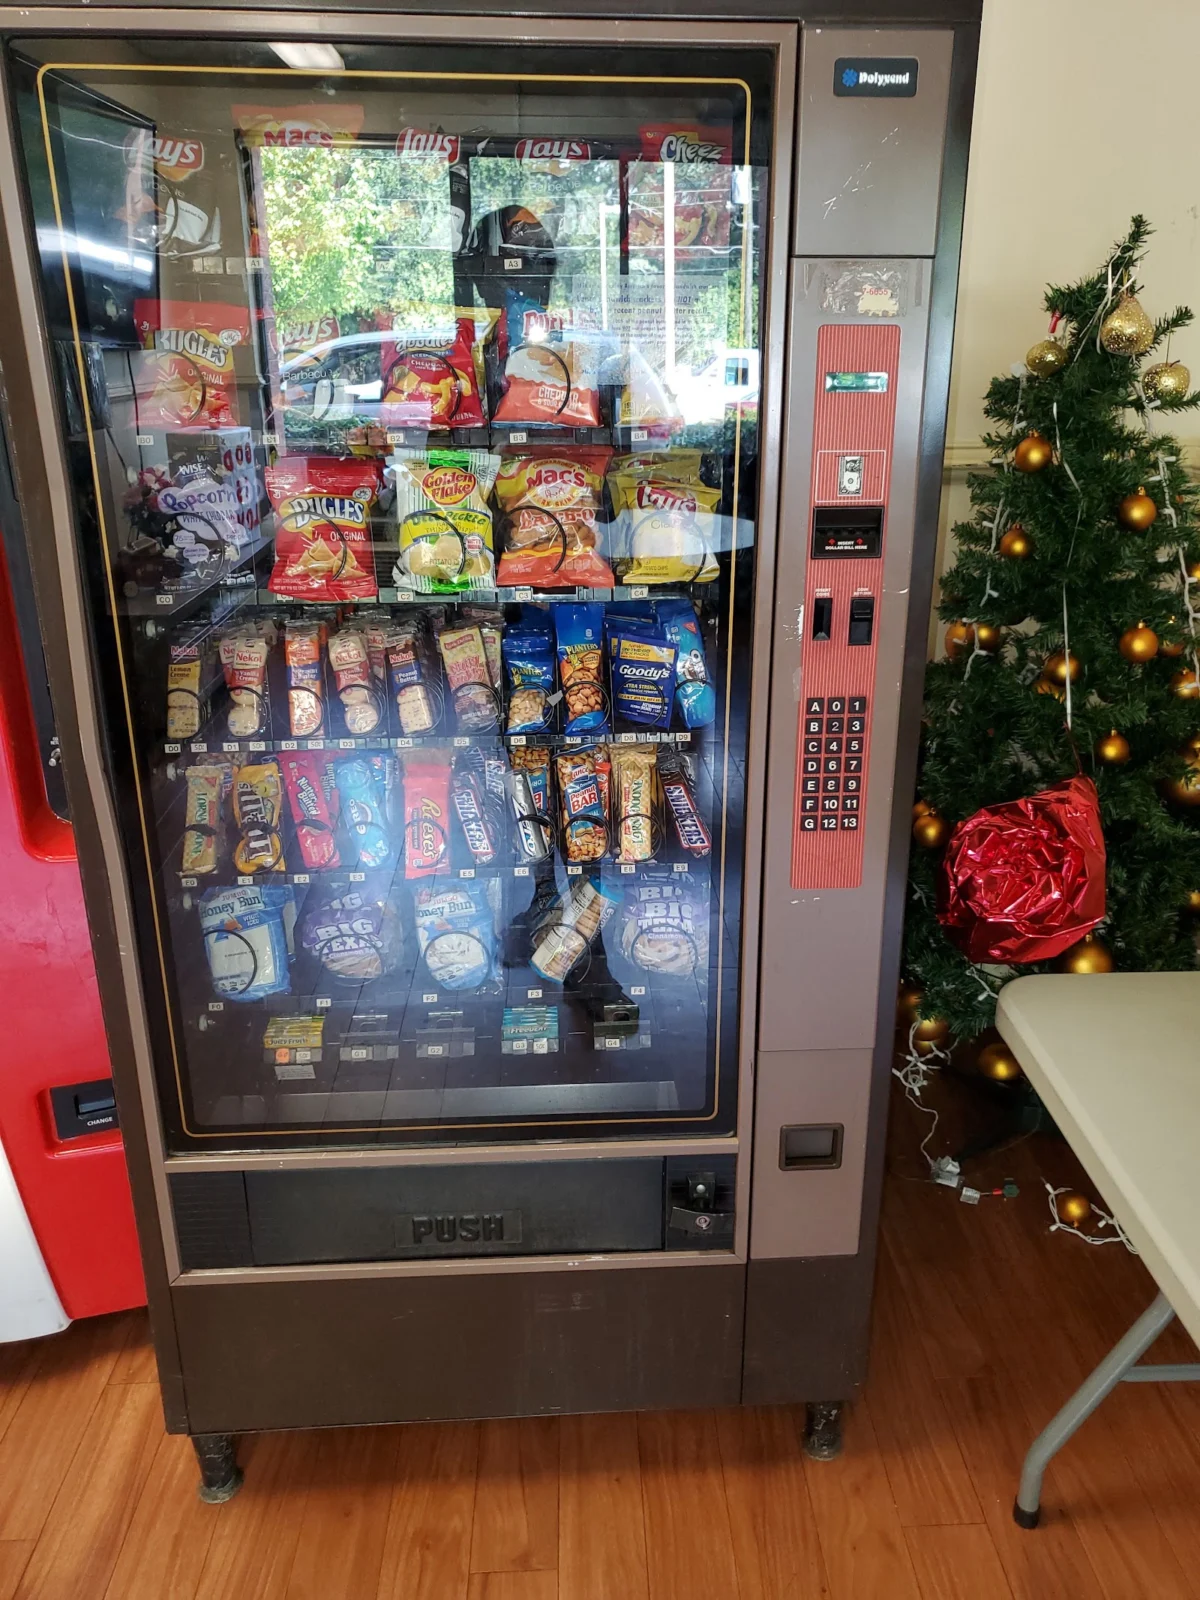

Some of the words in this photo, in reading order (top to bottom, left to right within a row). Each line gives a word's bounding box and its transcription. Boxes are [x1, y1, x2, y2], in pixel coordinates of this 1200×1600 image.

[859, 72, 909, 86] Polyvend
[660, 135, 727, 164] Cheez
[251, 259, 261, 268] A1
[508, 260, 519, 268] A3
[390, 434, 400, 442] B2
[634, 432, 645, 440] B4
[423, 472, 473, 488] Golden
[527, 469, 586, 489] Mac's
[431, 483, 471, 499] Flake
[161, 488, 237, 512] Popcorn
[289, 496, 364, 529] BUGLES
[330, 531, 366, 541] ORGINAL
[566, 643, 598, 655] PLANTERS
[235, 652, 262, 662] Nekot
[619, 664, 671, 680] Goody's
[811, 702, 820, 711] A
[832, 702, 841, 711] 0
[853, 701, 860, 711] 1
[810, 722, 819, 732] B
[832, 722, 839, 731] 2
[852, 721, 860, 731] 3
[809, 742, 818, 751] C
[829, 742, 838, 751] 4
[851, 741, 859, 750] 5
[808, 762, 817, 771] D
[829, 761, 836, 770] 6
[849, 761, 857, 770] 7
[297, 776, 318, 803] Nutter
[570, 784, 597, 799] Peanut
[807, 781, 815, 790] E
[848, 780, 856, 790] 9
[297, 791, 321, 815] Butter
[571, 792, 599, 814] BAR
[806, 800, 814, 809] F
[824, 800, 837, 809] 10
[845, 799, 857, 808] 11
[665, 785, 706, 846] SNICKERS
[421, 797, 441, 859] Reese's
[805, 819, 814, 829] G
[822, 819, 836, 828] 12
[843, 818, 857, 827] 13
[236, 895, 261, 907] Bun
[416, 905, 445, 918] oney
[448, 900, 473, 913] Bun
[315, 918, 374, 941] BIG
[87, 1116, 113, 1126] CHANGE
[412, 1213, 504, 1244] PUSH
